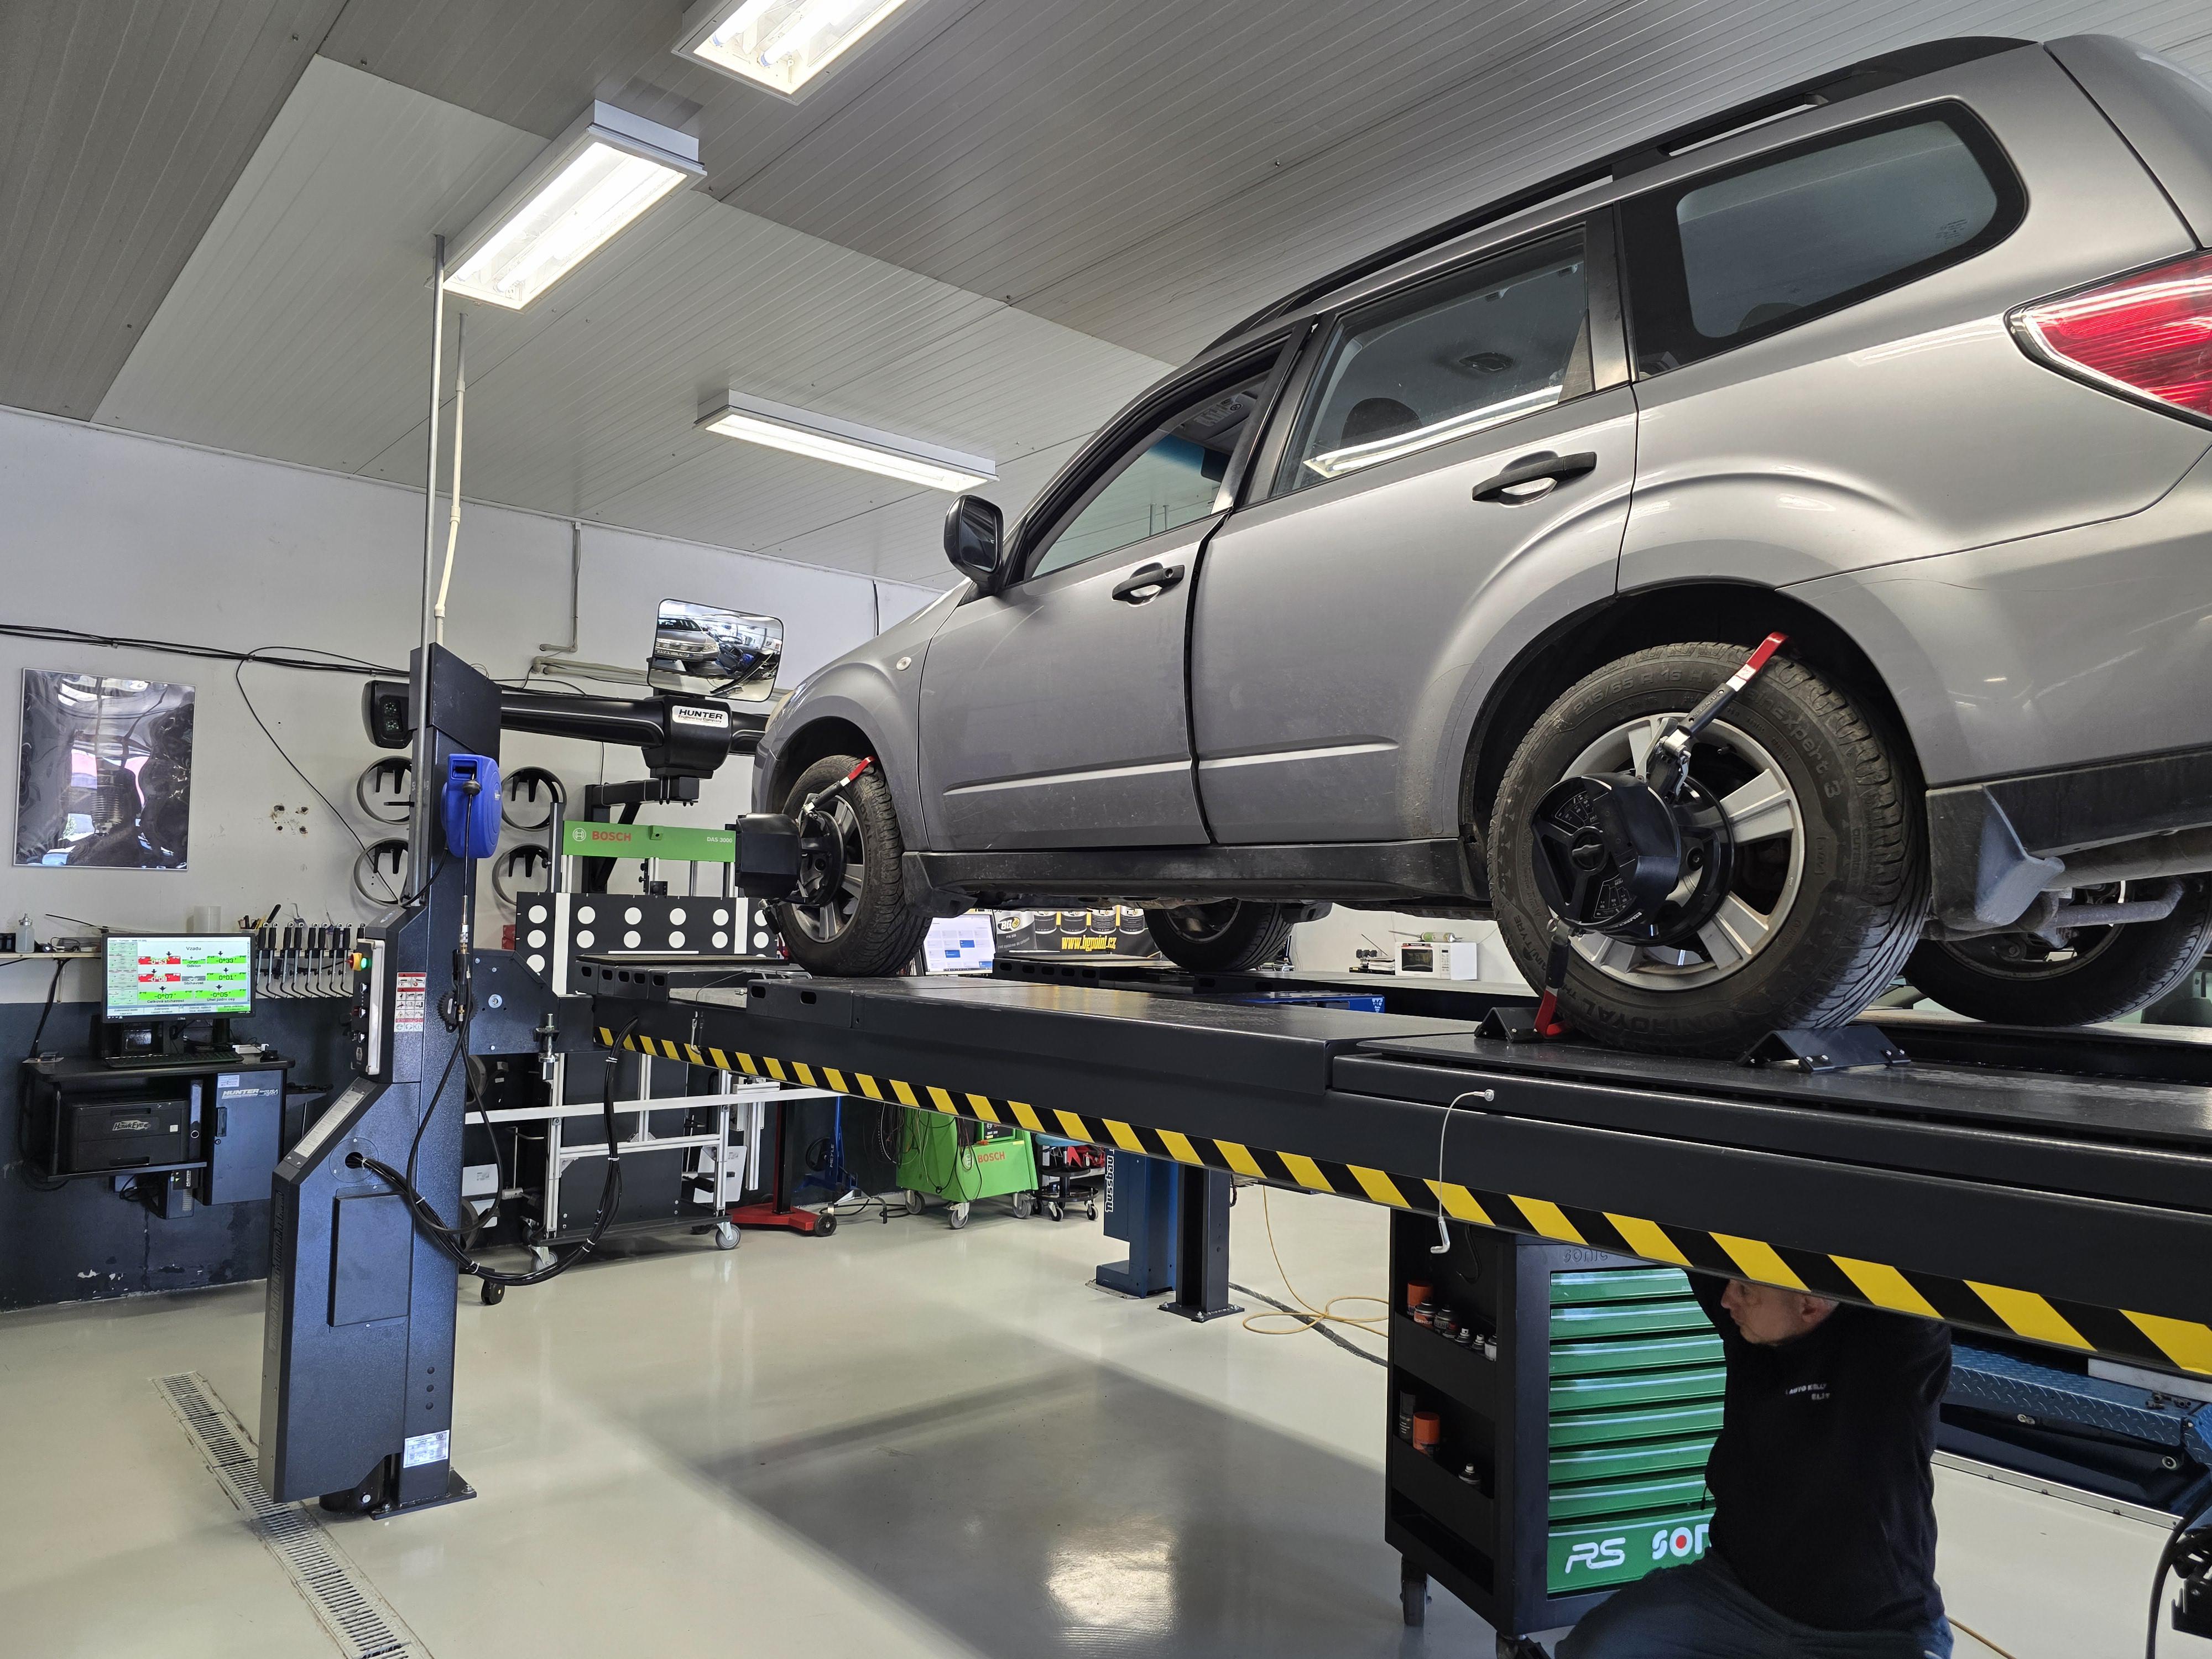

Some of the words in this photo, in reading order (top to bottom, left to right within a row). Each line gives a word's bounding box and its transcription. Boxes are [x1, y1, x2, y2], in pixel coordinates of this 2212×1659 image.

[1574, 677, 1635, 715] 215/65
[1641, 672, 1654, 685] R
[1661, 669, 1682, 682] 16
[679, 709, 723, 719] HUNTER
[1746, 688, 1829, 775] ainExpert
[592, 831, 632, 842] BOSCH
[1514, 915, 1532, 950] TYRE
[1530, 948, 1547, 971] AIN
[113, 1121, 144, 1130] HawkEye
[978, 1151, 1005, 1163] BOSCH
[1789, 1385, 1807, 1394] AUTO
[1652, 1523, 1712, 1560] son
